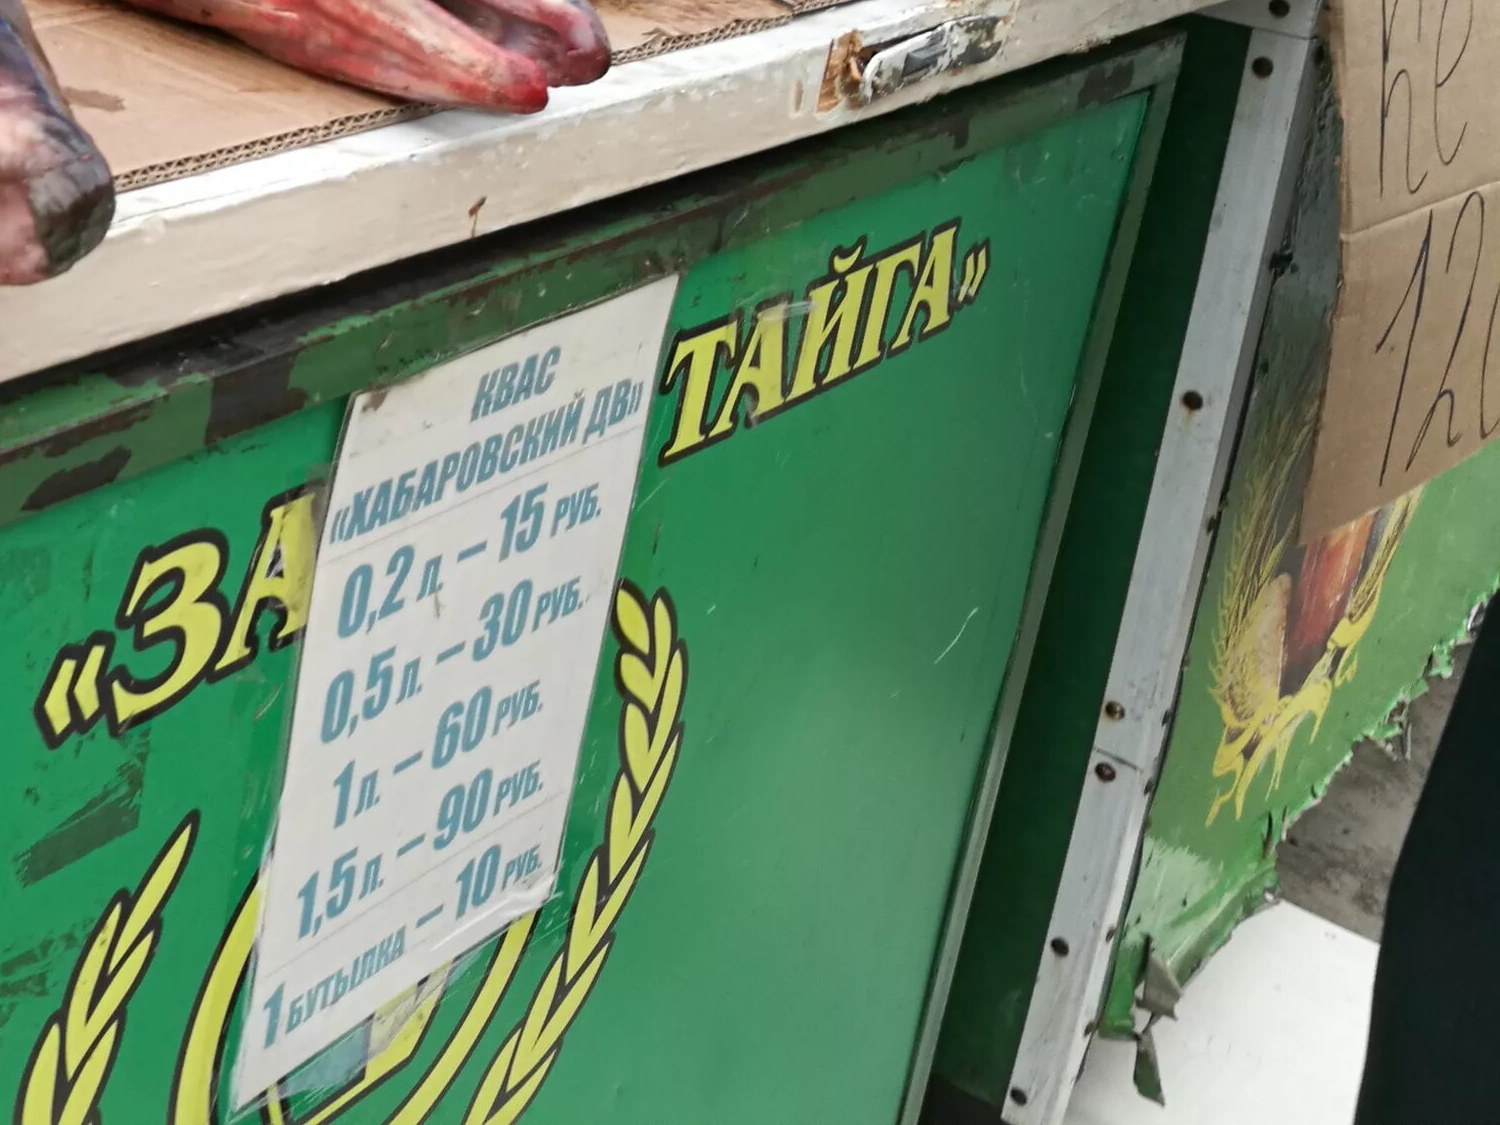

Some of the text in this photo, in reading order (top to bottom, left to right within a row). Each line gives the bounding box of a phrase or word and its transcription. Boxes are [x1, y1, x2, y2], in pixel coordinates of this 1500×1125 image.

[470, 345, 561, 422] КВАС
[658, 216, 990, 467] ТАЙГА»
[330, 378, 644, 544] «ХАБАРОВСКИЙ ДВ»
[337, 545, 415, 638] 0,2
[499, 482, 548, 563] 15
[550, 482, 601, 538] РУБ.
[320, 645, 396, 743] 0,5
[472, 578, 533, 662] 30
[532, 576, 584, 632] РУБ.
[333, 760, 355, 829] 1
[431, 685, 492, 770] 60
[492, 679, 543, 737] РУБ.
[297, 846, 358, 940] 1,5
[433, 768, 493, 850] 90
[493, 760, 543, 817] РУБ.
[263, 982, 285, 1049] 1
[285, 925, 406, 1034] БУТЫЛКА
[455, 843, 501, 921] 10
[501, 844, 542, 892] РУБ.
